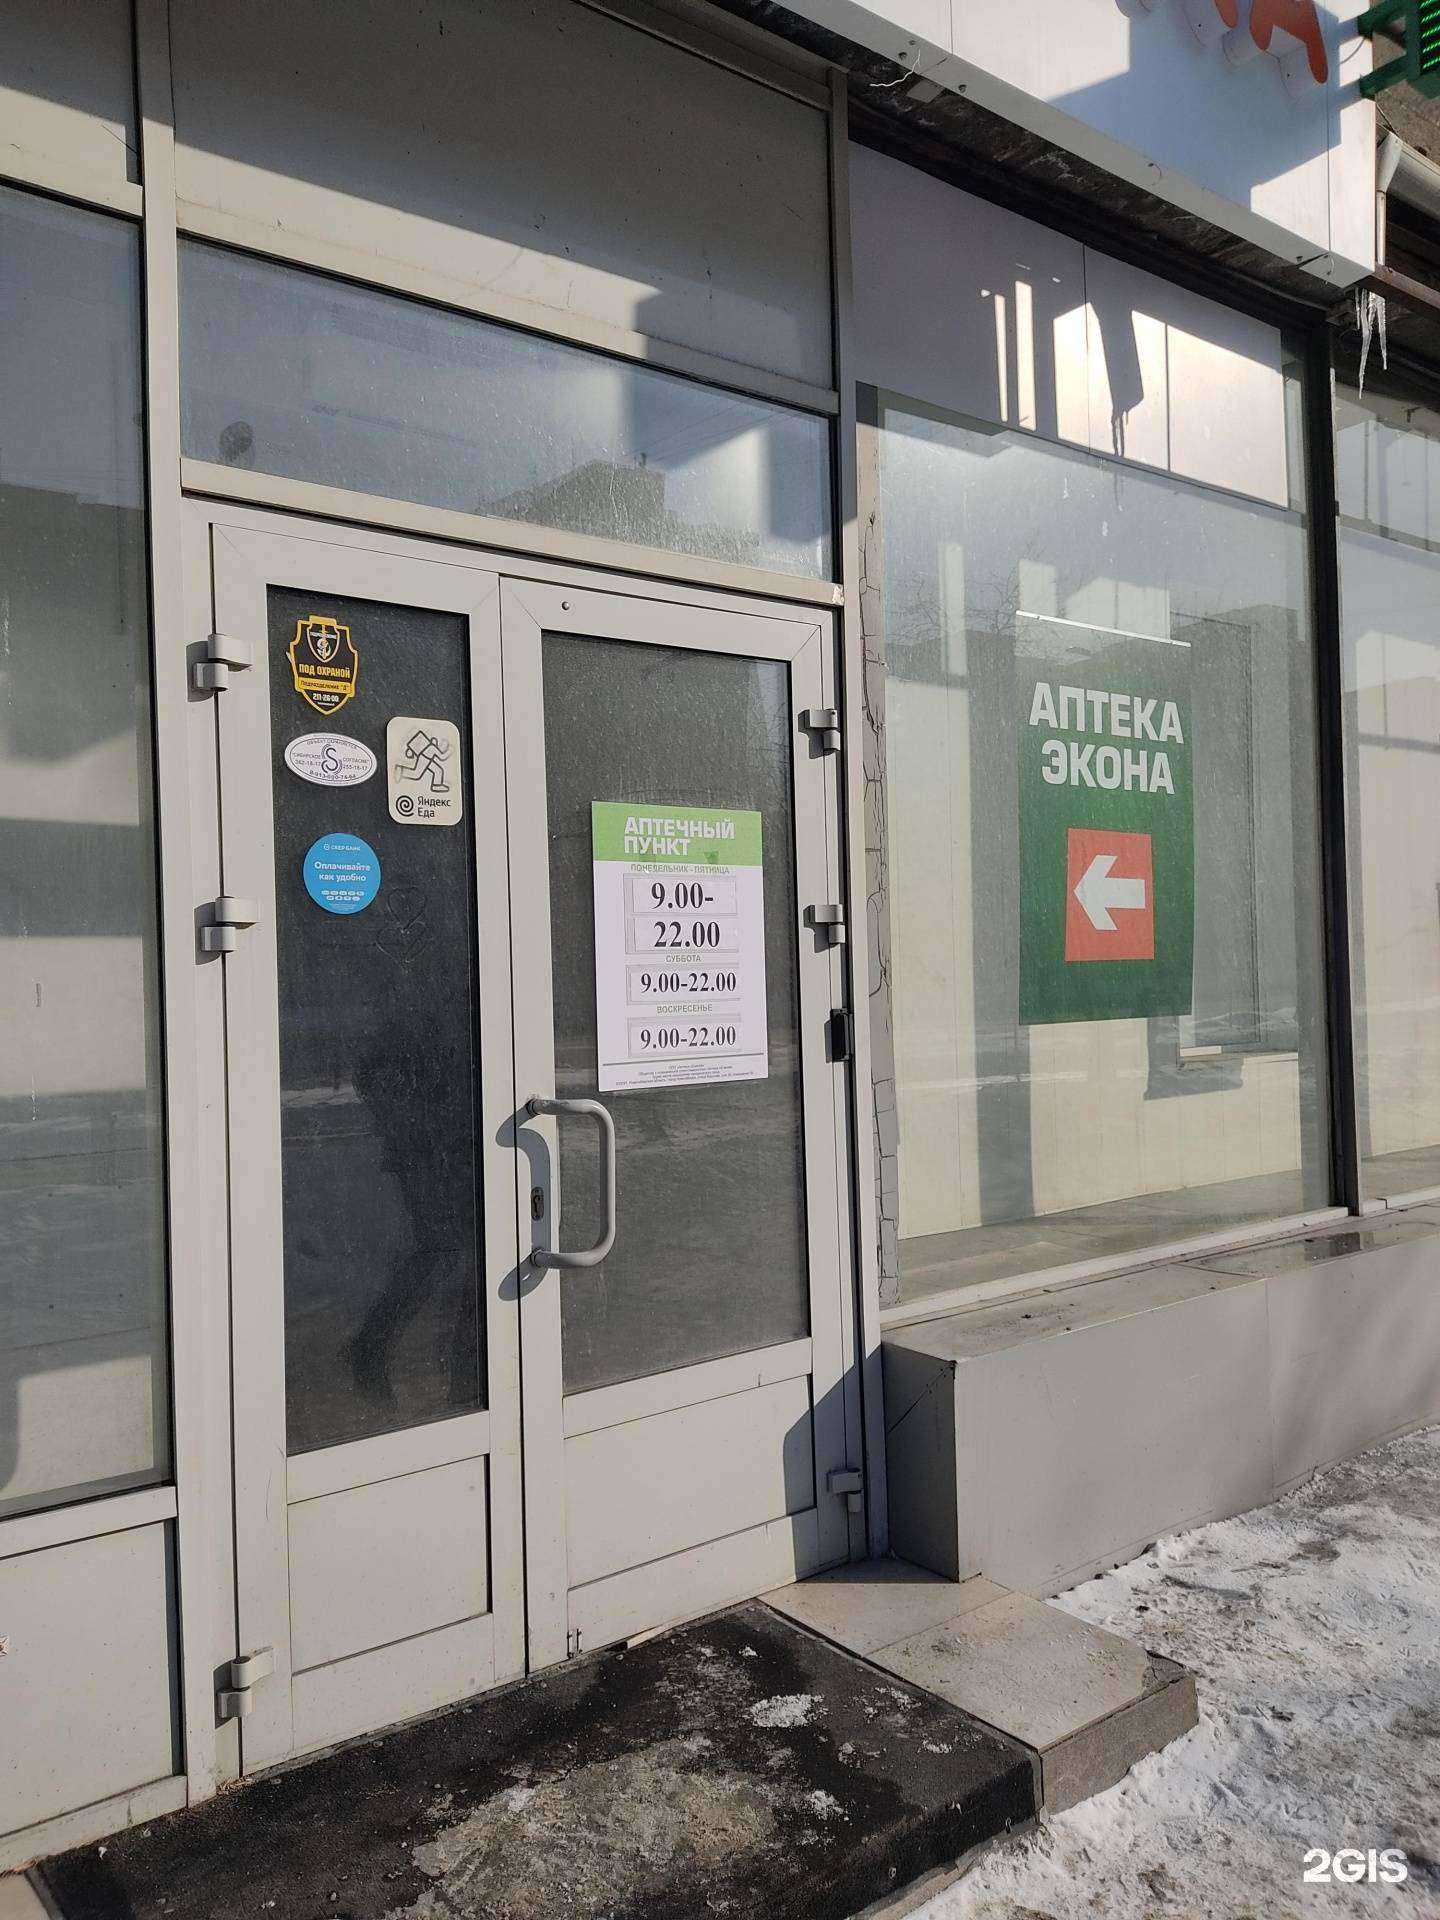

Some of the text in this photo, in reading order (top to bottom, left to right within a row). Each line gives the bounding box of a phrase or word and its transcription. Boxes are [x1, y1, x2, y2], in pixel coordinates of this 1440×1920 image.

[299, 664, 350, 678] ПОД ОХРАНОЙ
[1029, 682, 1184, 744] АПТЕКА
[1042, 739, 1175, 794] ЭКОНА
[417, 796, 451, 807] Яндекс
[417, 807, 435, 818] Еда
[624, 816, 735, 839] АПТЕЧНЫЙ
[624, 836, 690, 856] ПУНКТ
[314, 861, 371, 872] Оплачивайте
[631, 864, 688, 873] ПОНЕДЕЛЬНИК
[694, 866, 730, 874] ПЯТНИЦА
[336, 873, 367, 882] удобно
[651, 882, 713, 909] 9.00-
[654, 921, 720, 947] 22.00
[666, 955, 701, 963] СУББОТА
[640, 972, 736, 993] 9.00-22.00
[656, 1004, 713, 1014] ВОСКРЕСЕНЬЕ
[640, 1026, 736, 1050] 9.00-22.00
